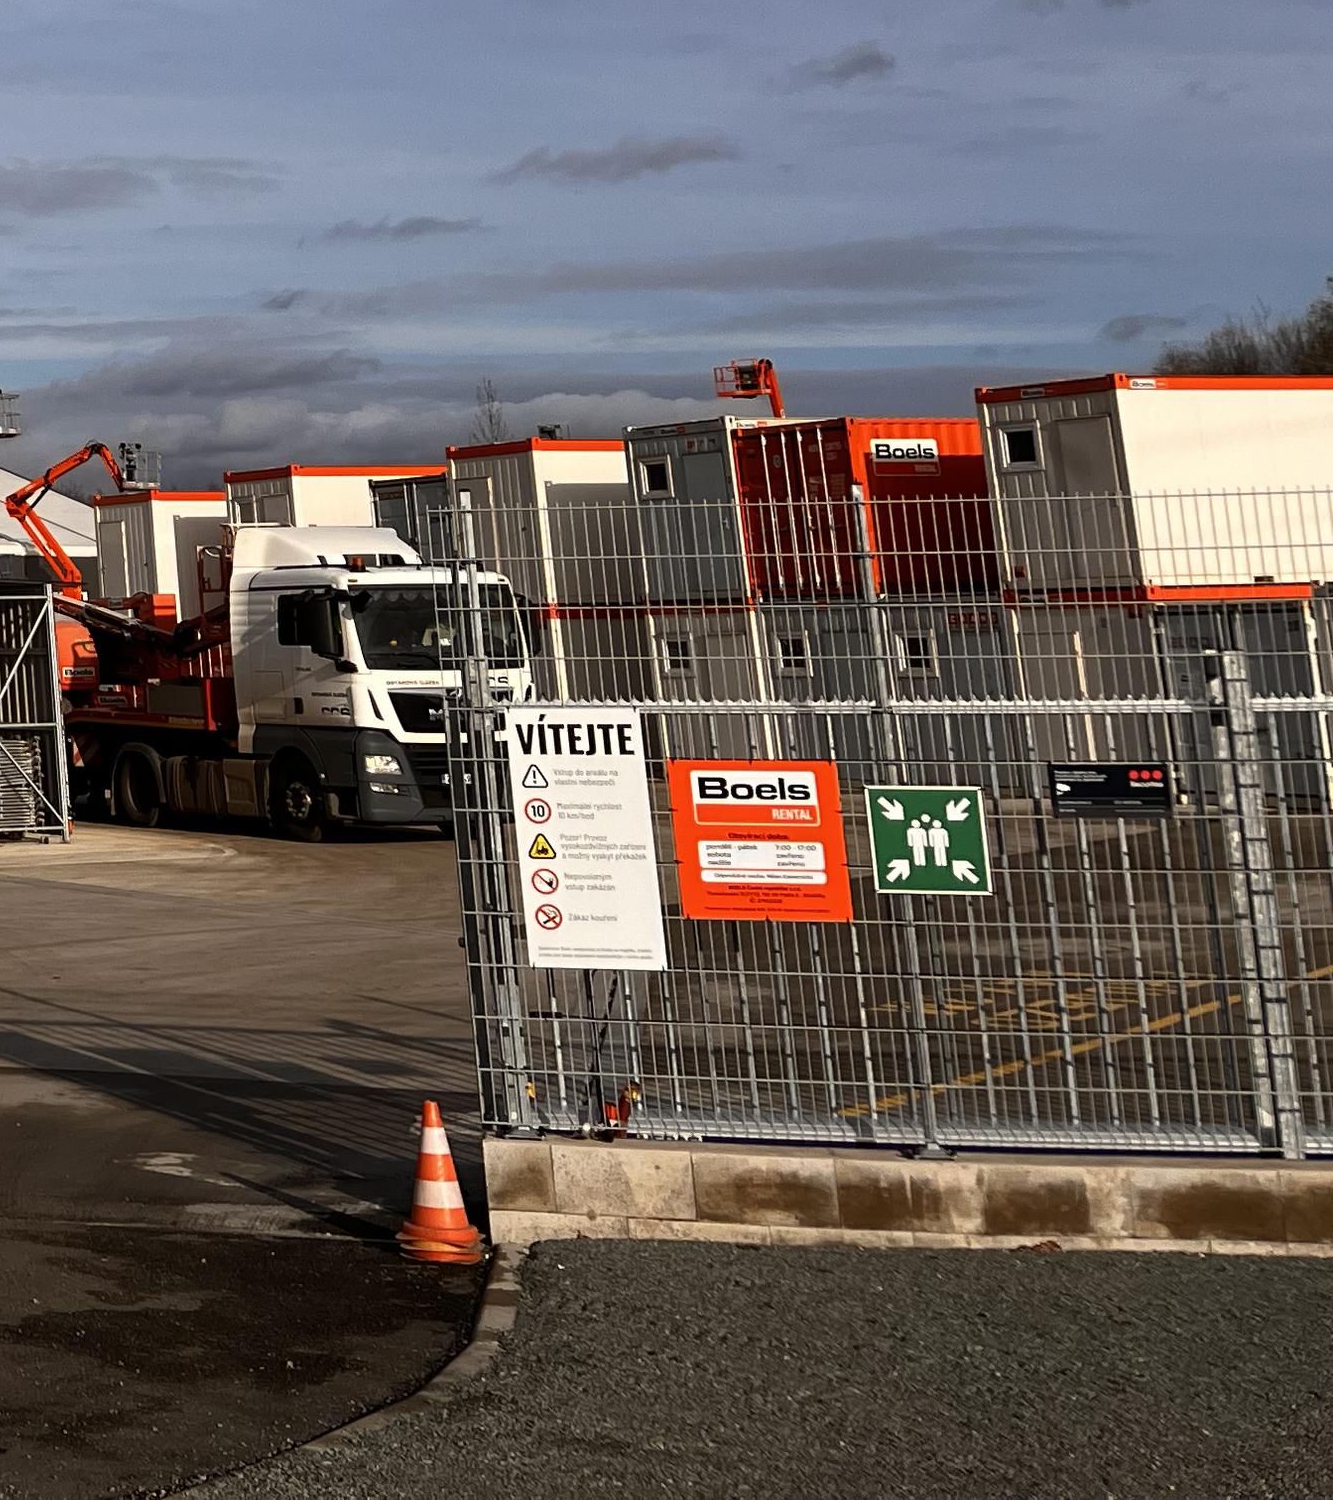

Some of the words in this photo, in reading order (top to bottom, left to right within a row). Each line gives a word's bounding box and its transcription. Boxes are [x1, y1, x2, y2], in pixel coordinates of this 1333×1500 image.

[875, 443, 935, 459] Boels
[515, 714, 636, 755] VÍTEJTE
[698, 776, 811, 800] Boels
[531, 805, 545, 818] 10
[772, 808, 813, 820] RENTAL
